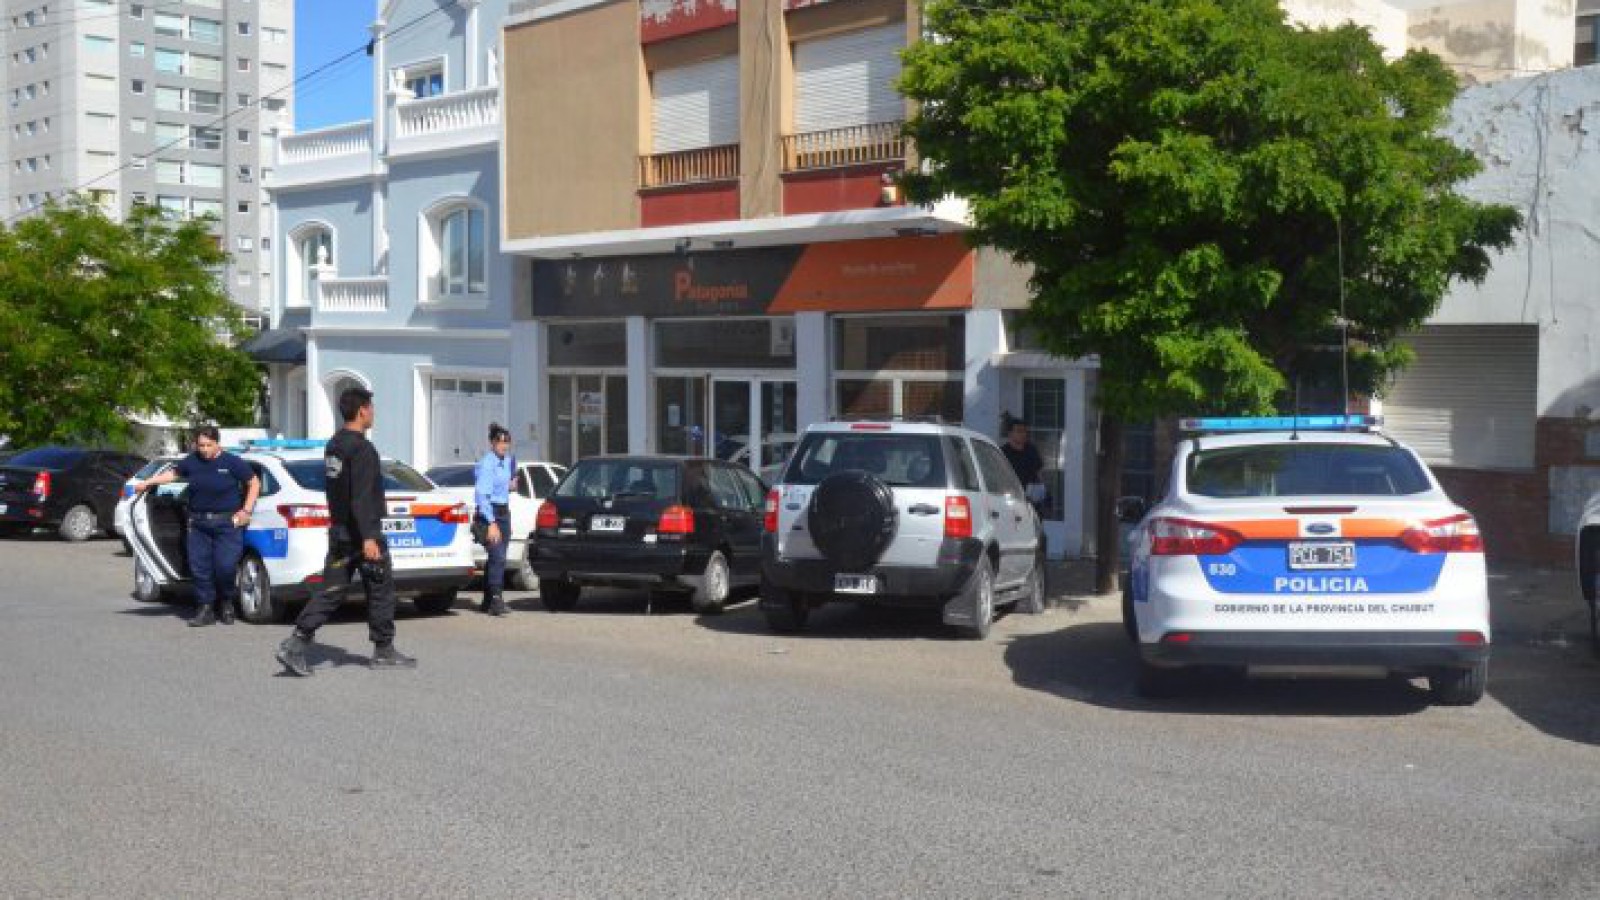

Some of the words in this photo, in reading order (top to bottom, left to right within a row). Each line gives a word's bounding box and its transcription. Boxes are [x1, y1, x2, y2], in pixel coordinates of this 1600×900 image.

[387, 537, 423, 547] LICIA
[1275, 577, 1369, 592] POLICIA
[1214, 603, 1270, 614] GOBIERNO
[1272, 603, 1286, 614] DE
[1288, 603, 1304, 614] LA
[1306, 603, 1365, 614] PROVINCIA
[1367, 603, 1389, 614] DEL
[1390, 603, 1435, 614] CHUBUT
